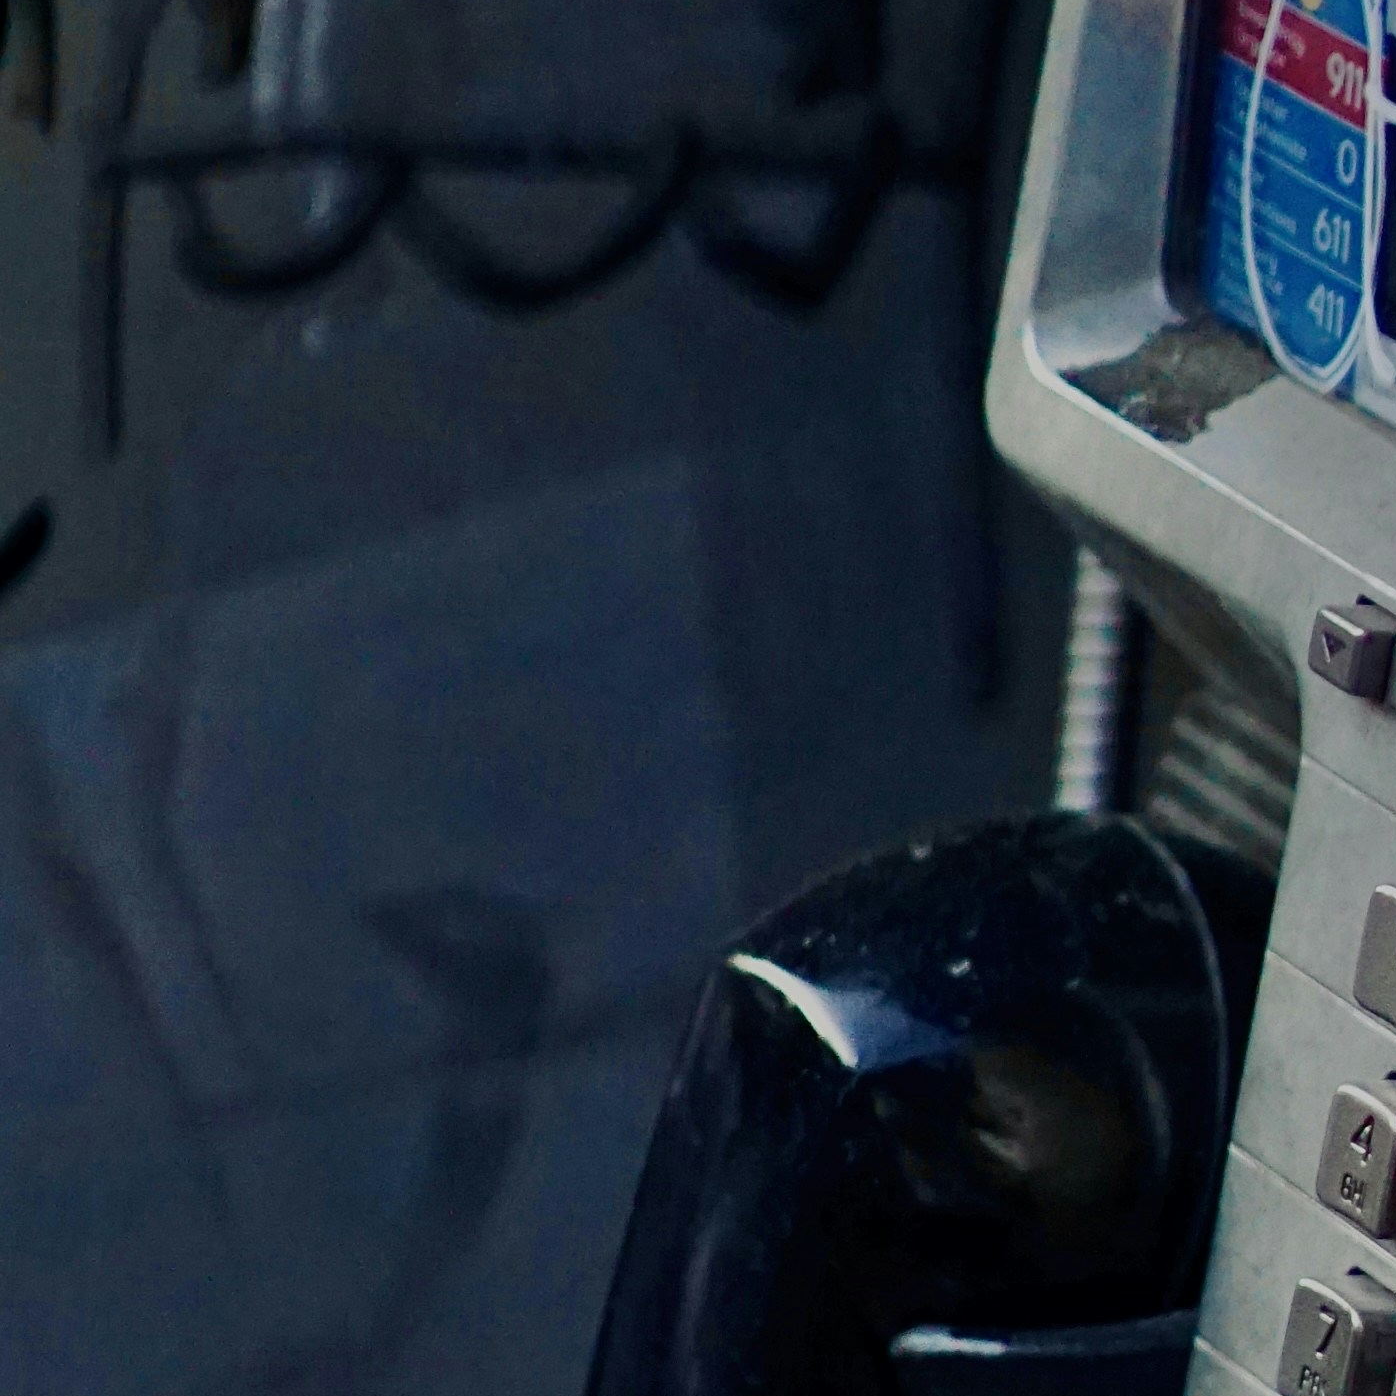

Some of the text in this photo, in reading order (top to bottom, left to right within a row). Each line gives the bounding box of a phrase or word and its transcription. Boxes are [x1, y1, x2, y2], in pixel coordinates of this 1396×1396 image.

[1323, 47, 1365, 114] 911
[1334, 134, 1359, 191] 0
[1311, 202, 1352, 267] 611
[1304, 276, 1347, 341] 411
[1350, 1115, 1375, 1167] 4
[1315, 1304, 1338, 1359] 7
